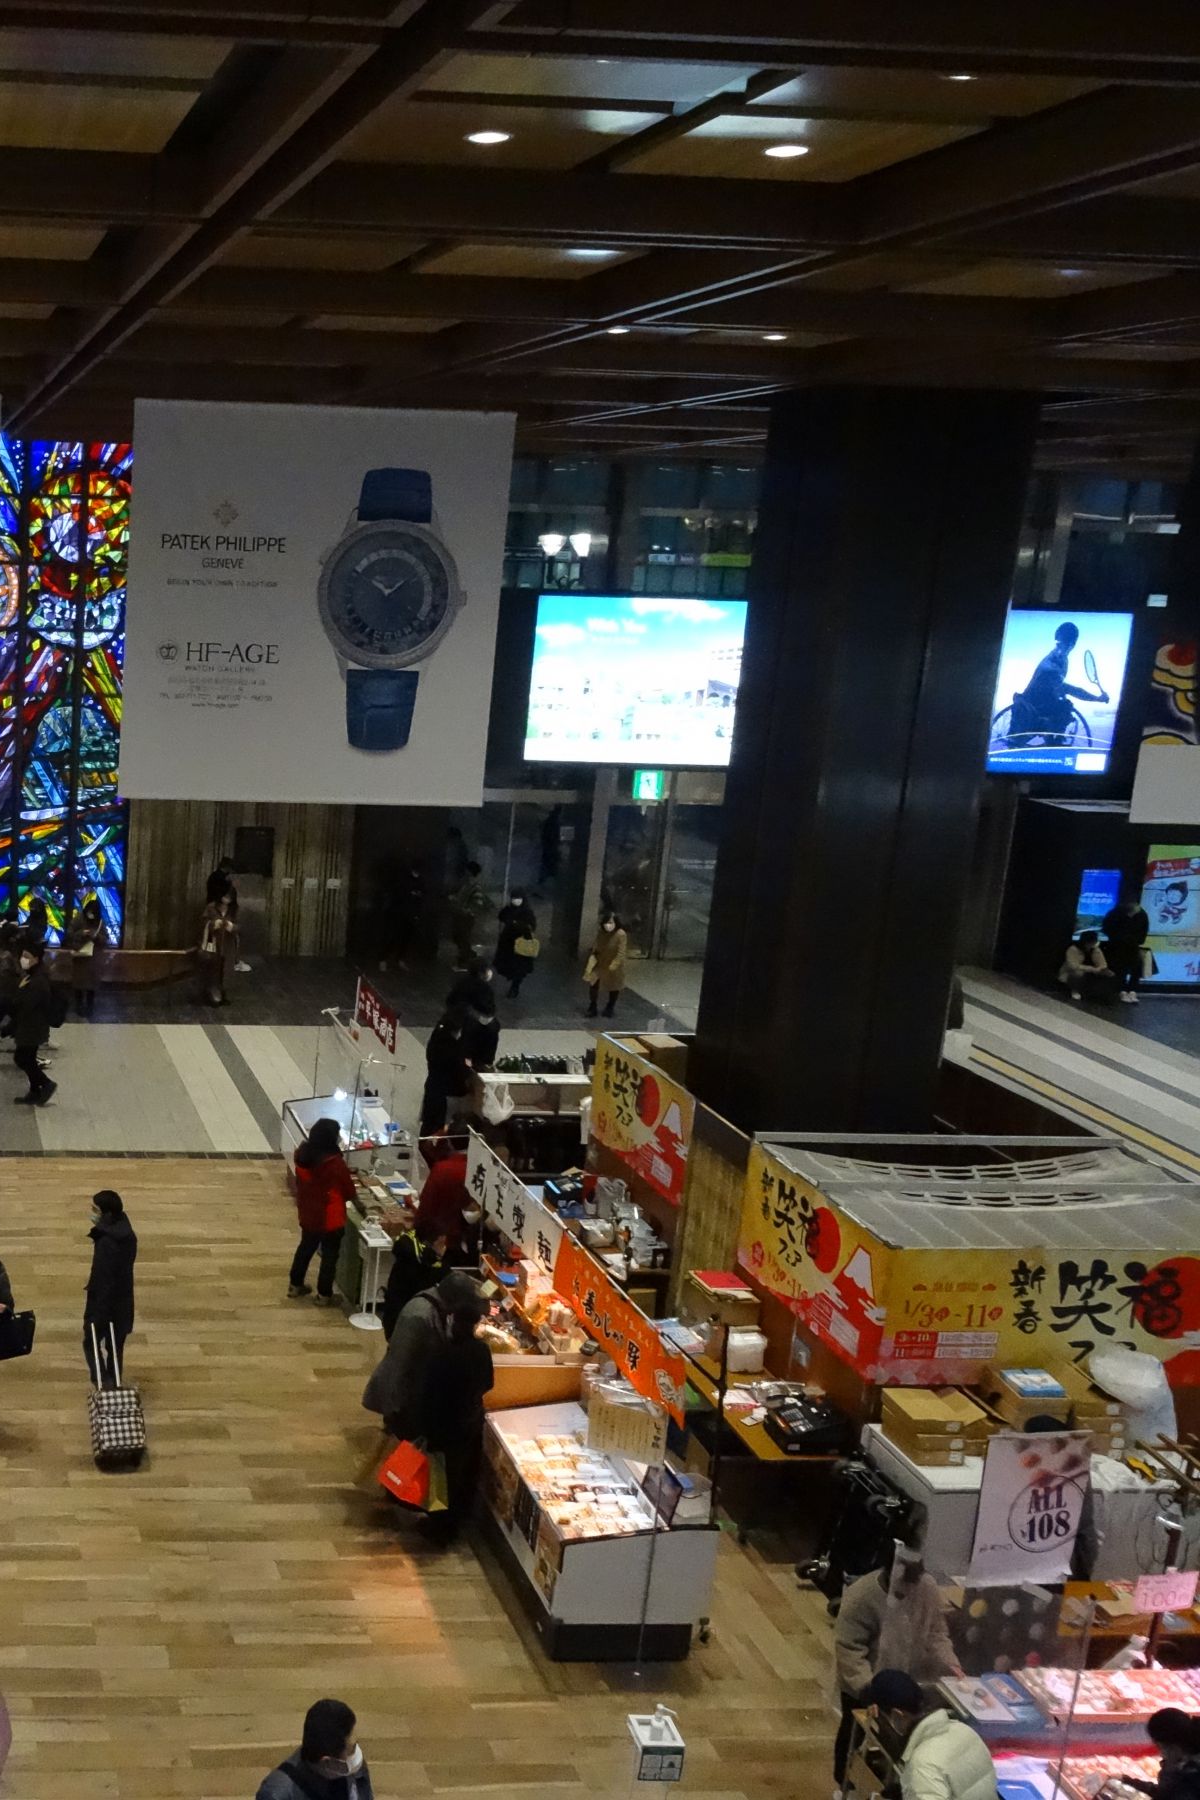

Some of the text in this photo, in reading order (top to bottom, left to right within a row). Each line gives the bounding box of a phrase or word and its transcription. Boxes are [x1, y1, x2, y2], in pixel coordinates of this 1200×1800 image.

[161, 533, 287, 553] PATEK PHILIPPE
[186, 642, 280, 664] HF-AGE
[1009, 1259, 1048, 1335] 新春
[1048, 1259, 1183, 1339] 笑福
[1028, 1485, 1068, 1515] ALL
